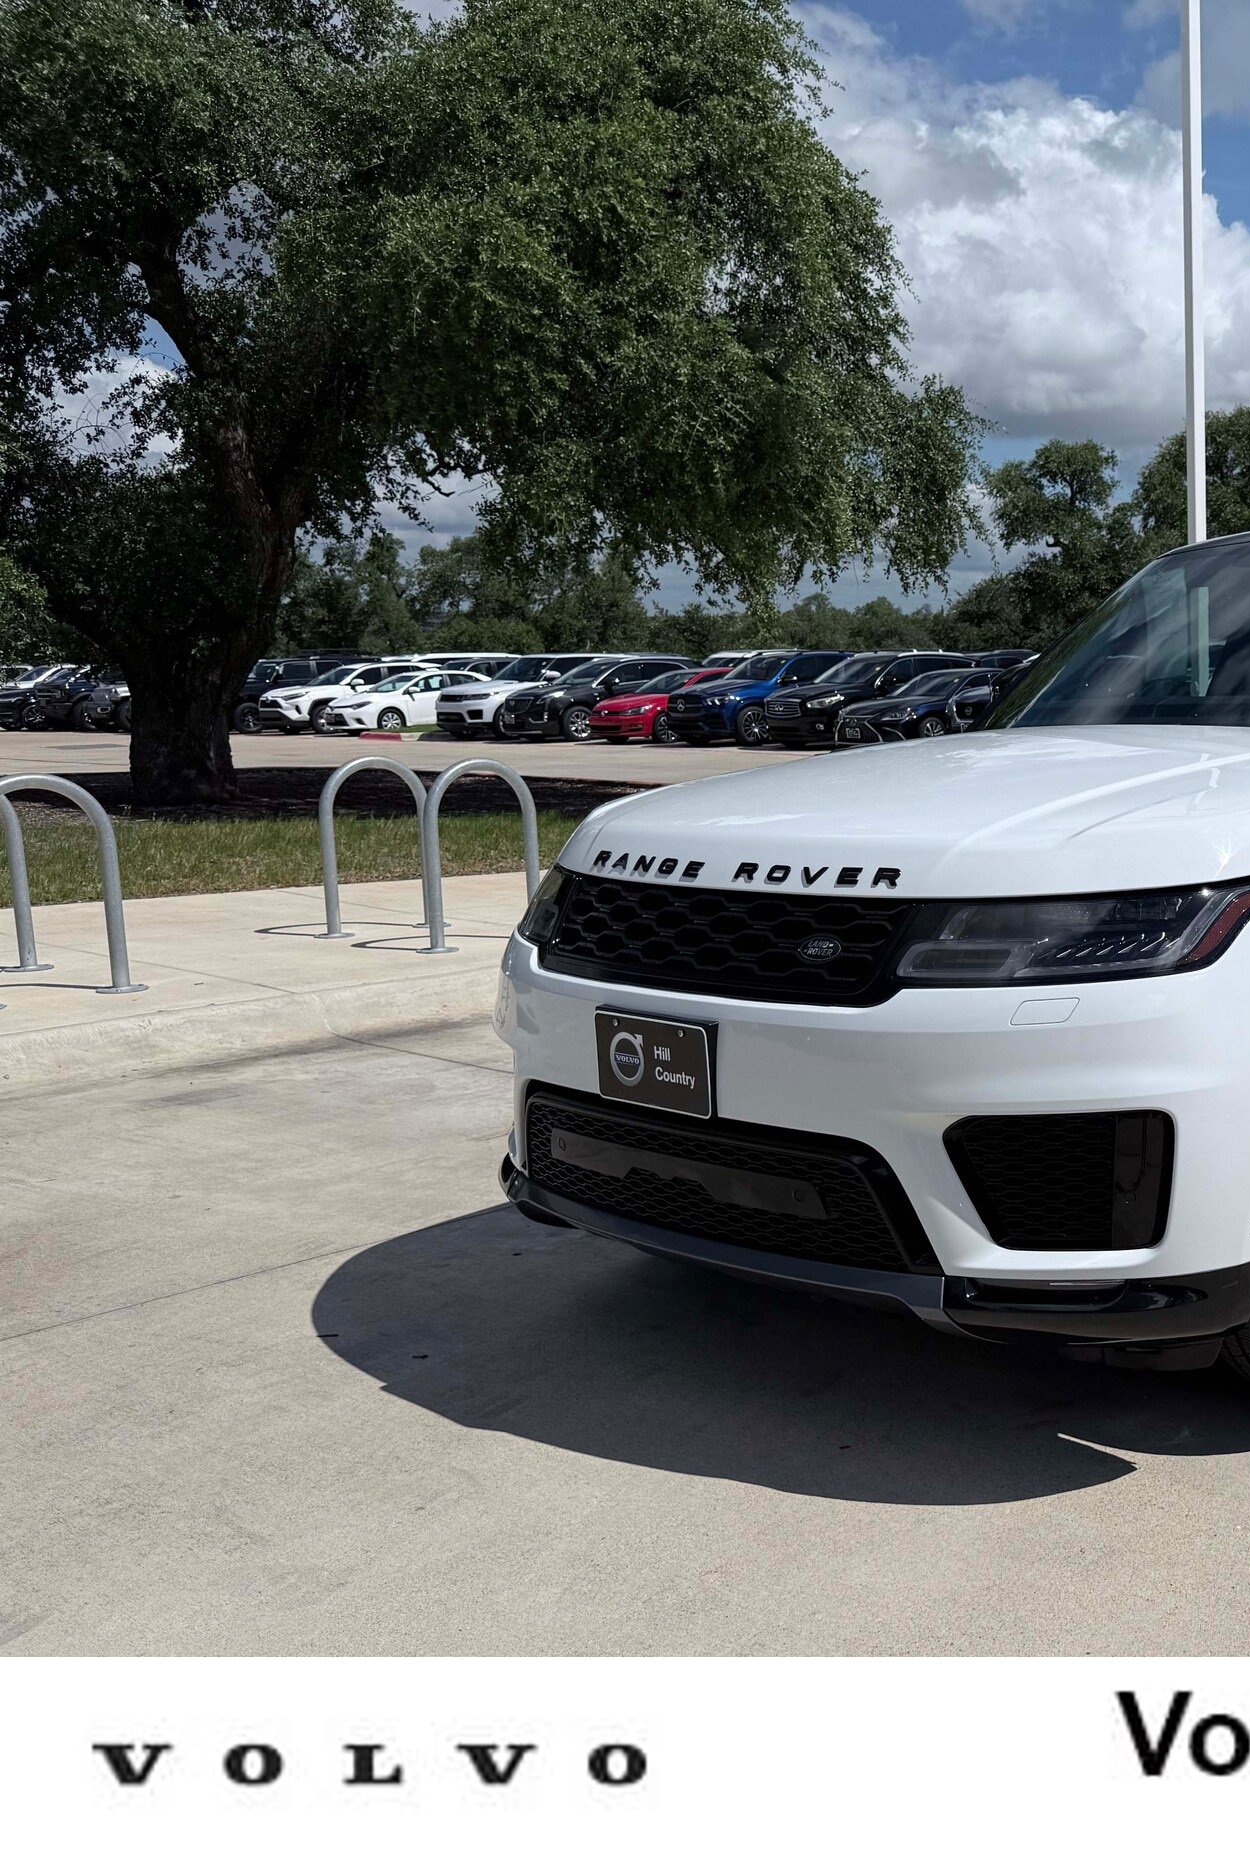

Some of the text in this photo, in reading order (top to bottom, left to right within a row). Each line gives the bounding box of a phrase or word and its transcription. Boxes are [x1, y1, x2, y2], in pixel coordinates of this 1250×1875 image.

[593, 850, 902, 888] RANGE ROVER
[615, 1054, 639, 1064] VOLVO
[653, 1045, 671, 1061] Hill
[655, 1066, 695, 1088] Country
